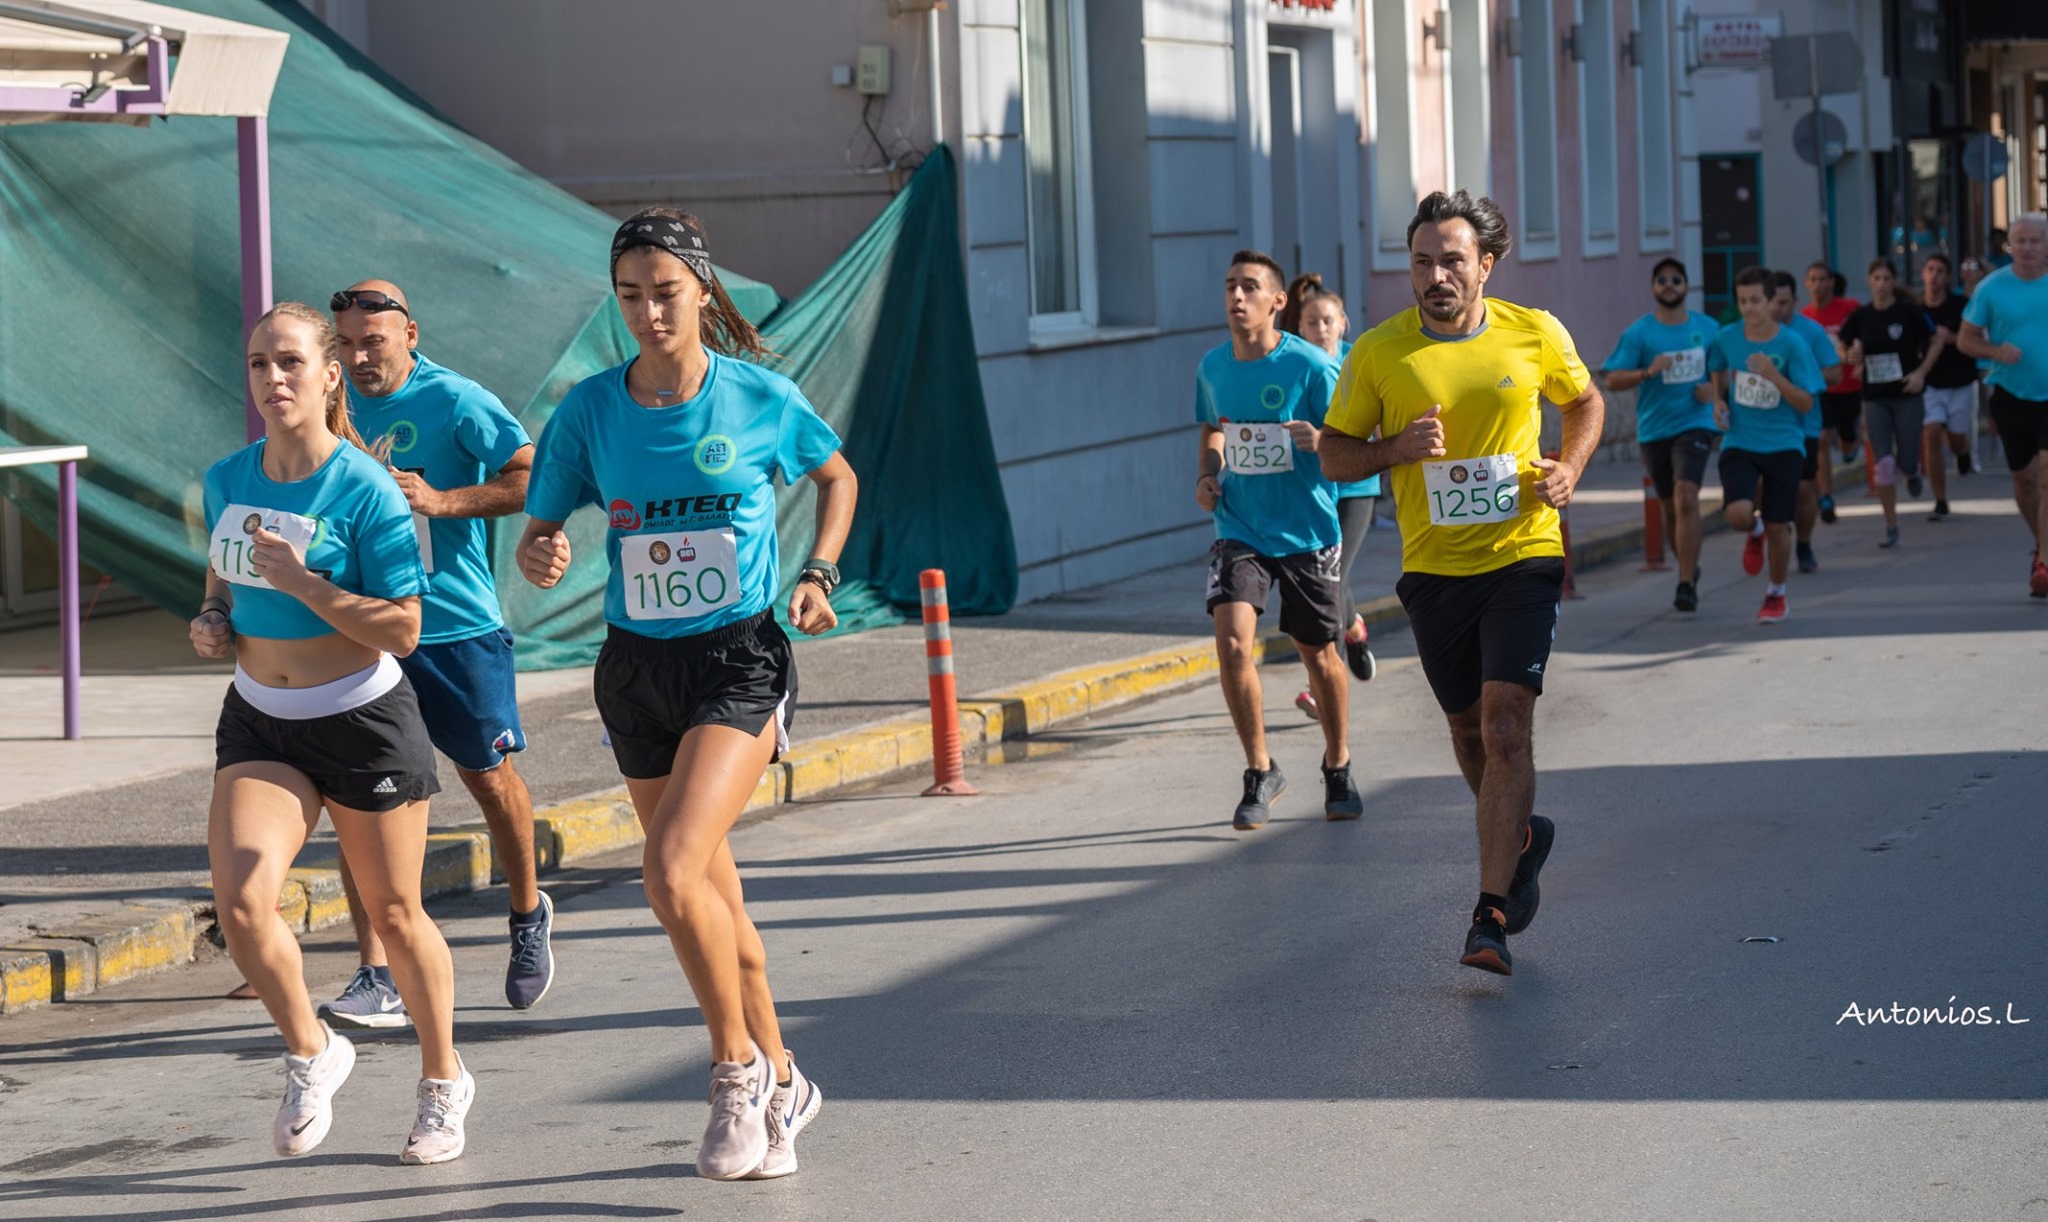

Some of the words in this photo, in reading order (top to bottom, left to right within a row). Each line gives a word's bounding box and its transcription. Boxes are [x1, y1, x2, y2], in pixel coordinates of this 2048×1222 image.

[1230, 445, 1287, 468] 1252
[1432, 483, 1514, 518] 1256
[634, 567, 726, 609] 1160
